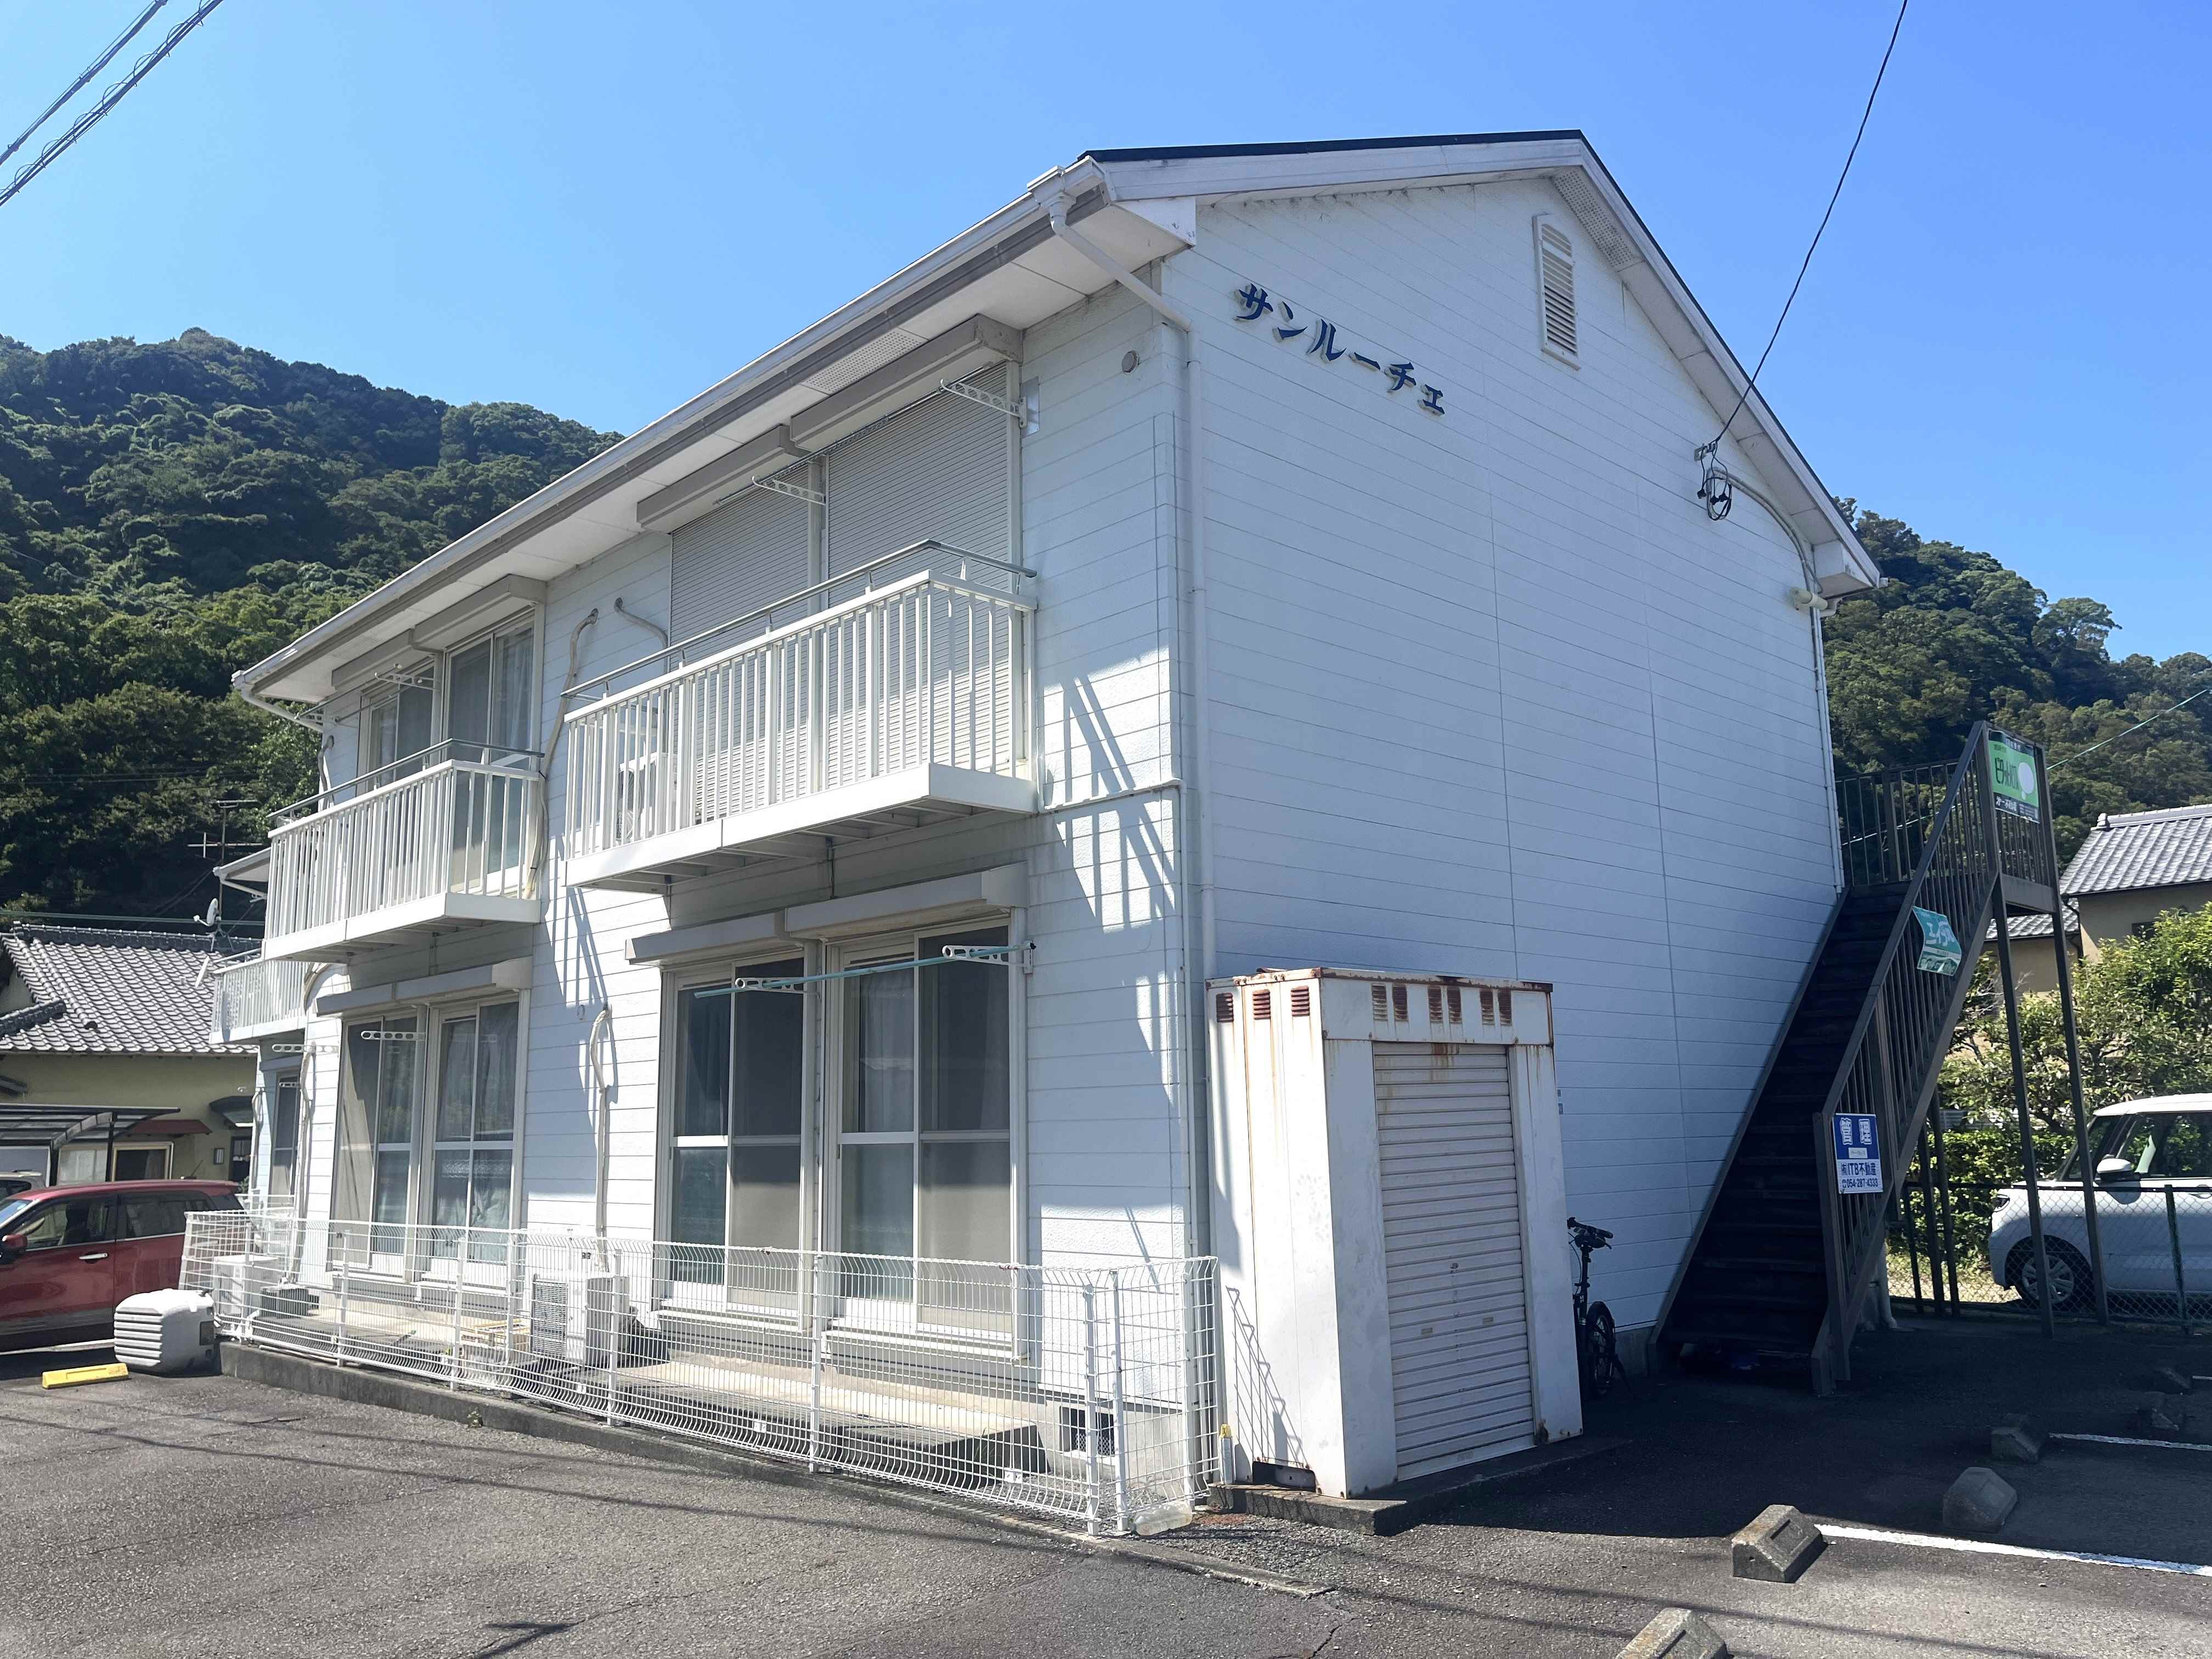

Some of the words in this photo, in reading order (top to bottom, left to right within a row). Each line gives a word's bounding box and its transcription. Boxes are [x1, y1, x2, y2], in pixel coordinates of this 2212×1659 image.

[1233, 283, 1445, 416] サンルーチェ
[1839, 1118, 1872, 1145] 管理
